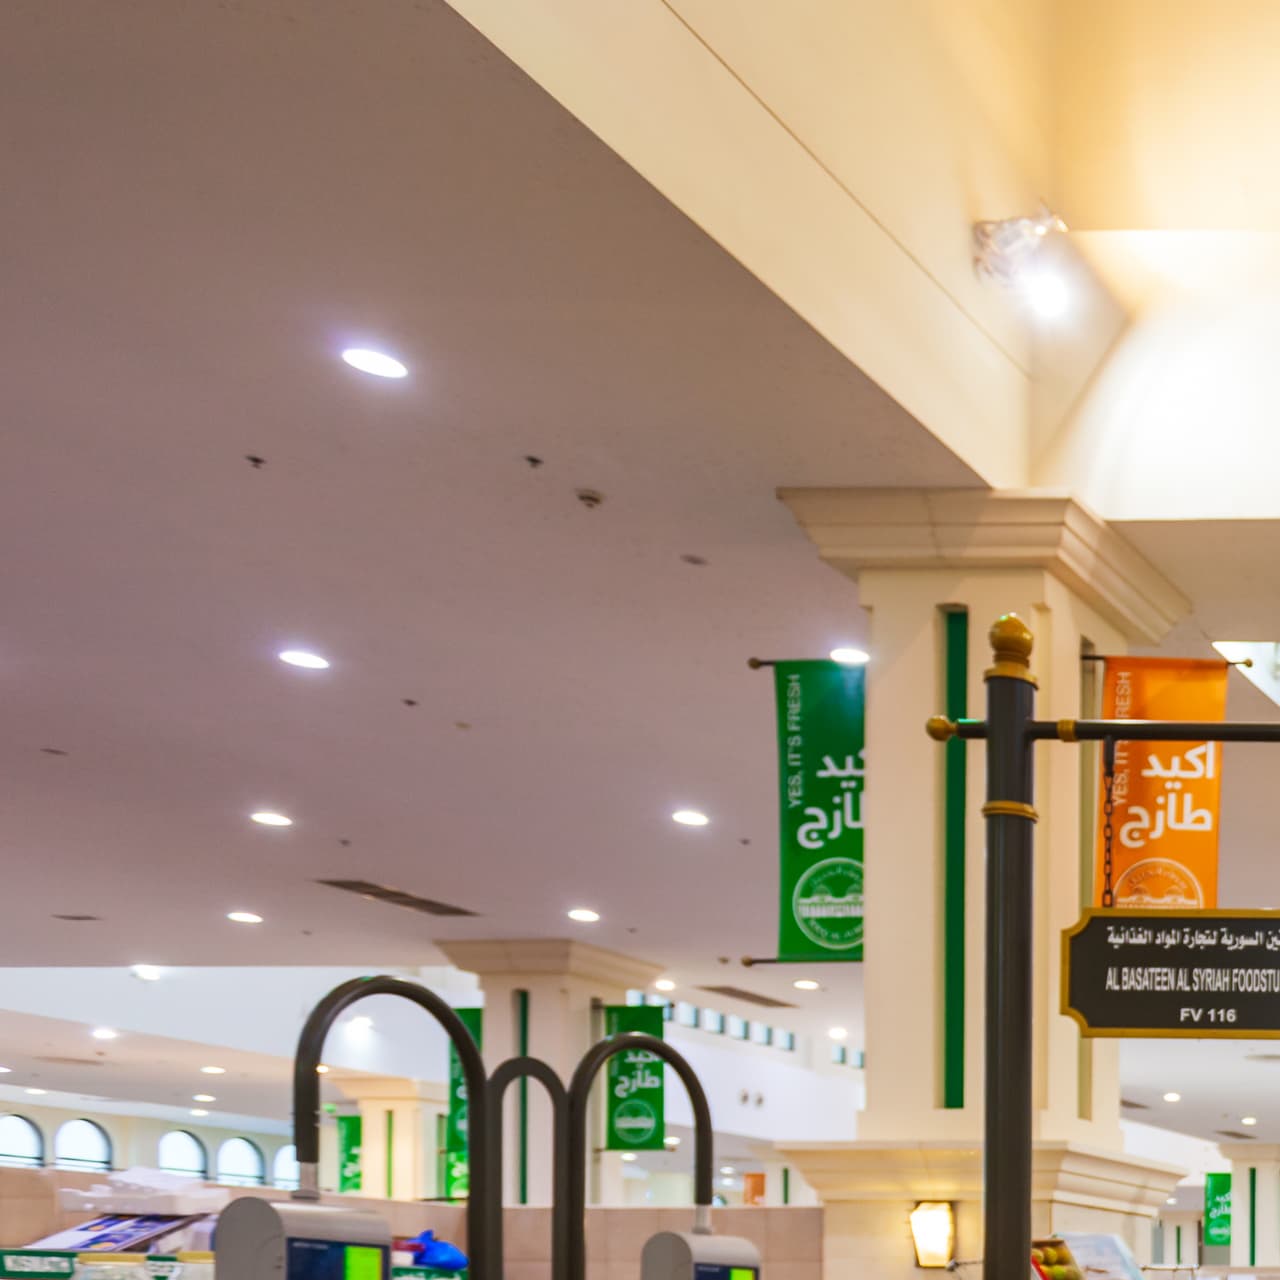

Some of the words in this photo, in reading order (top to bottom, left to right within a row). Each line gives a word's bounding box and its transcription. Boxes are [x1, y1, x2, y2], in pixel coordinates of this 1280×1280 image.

[787, 674, 803, 732] FRESH
[1115, 671, 1132, 720] RESH
[1119, 793, 1213, 849] طازج
[1155, 926, 1180, 949] المواد
[1183, 927, 1217, 949] لتجارة
[1220, 927, 1263, 950] السورية
[1105, 967, 1120, 991] AL
[1121, 967, 1175, 992] BASATEEN
[1176, 968, 1191, 992] AL
[1192, 968, 1231, 992] SYRIAH
[1180, 1008, 1202, 1022] FV
[1207, 1008, 1237, 1022] 116
